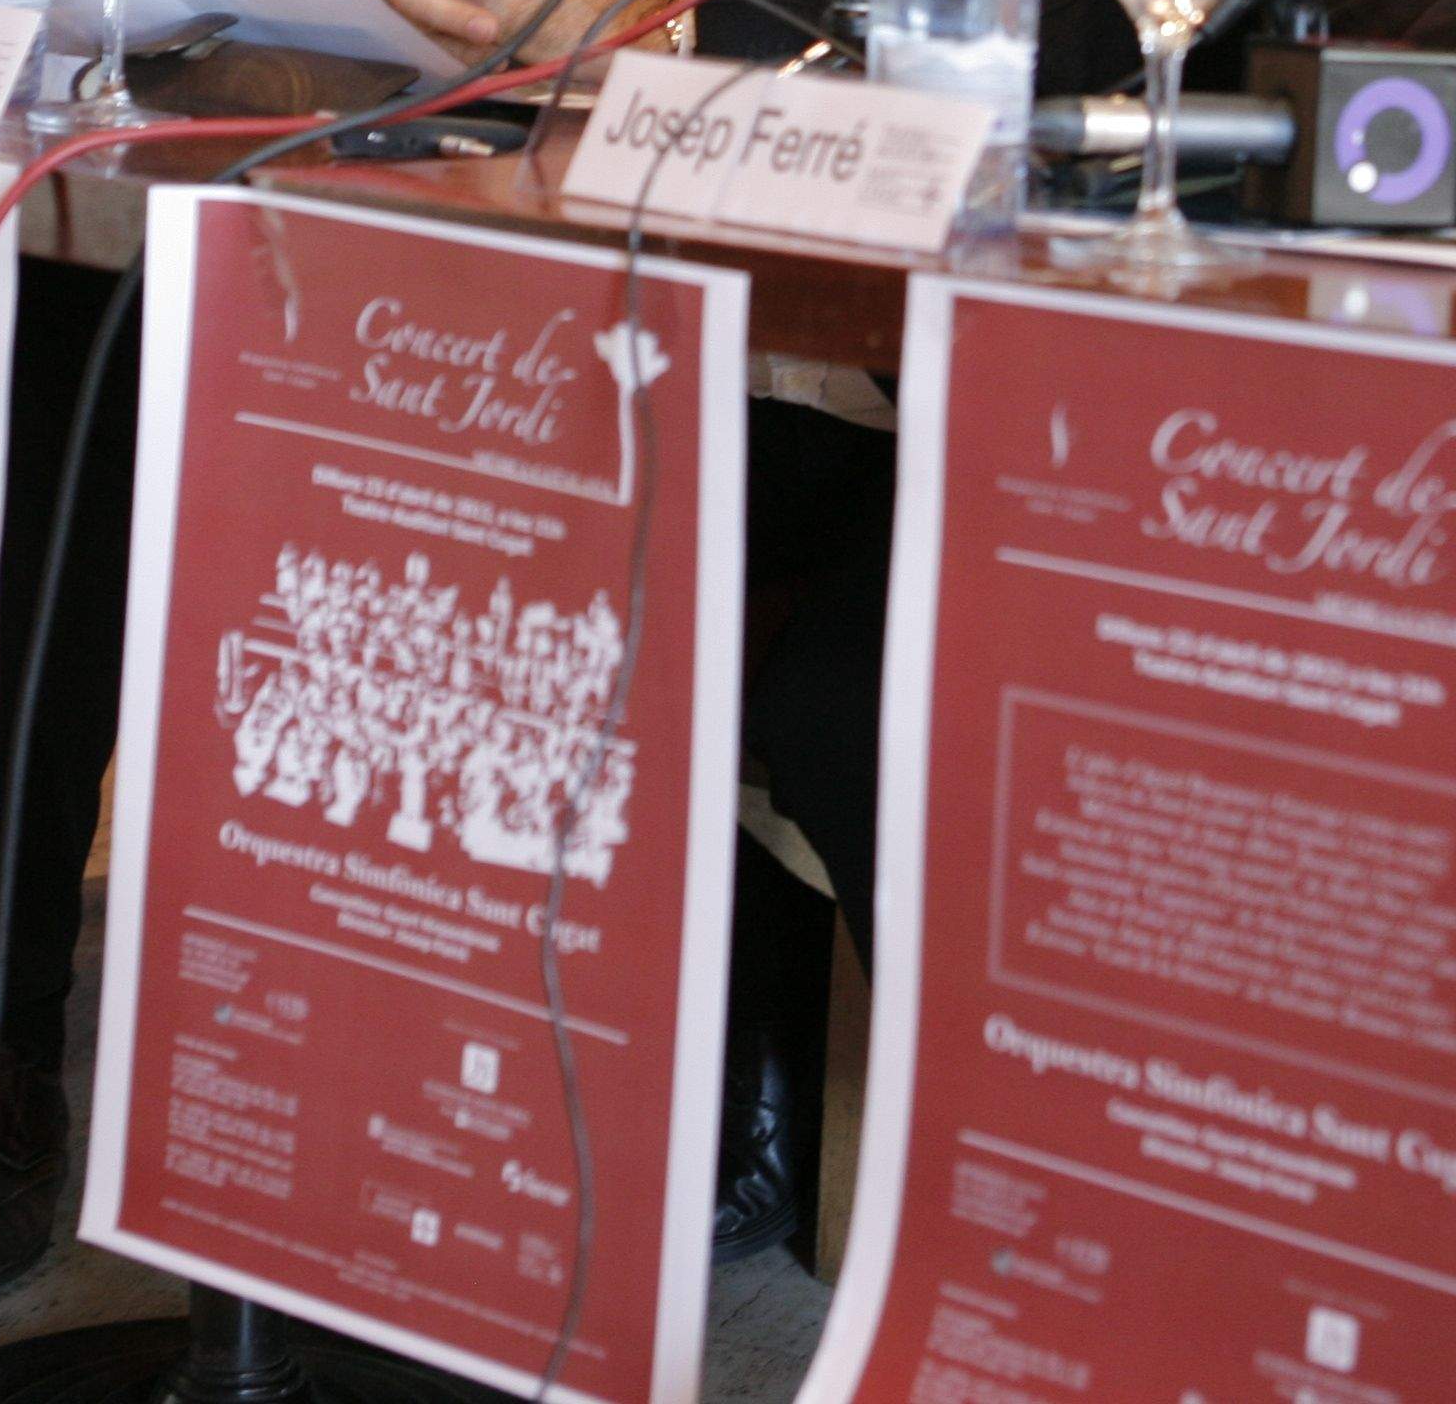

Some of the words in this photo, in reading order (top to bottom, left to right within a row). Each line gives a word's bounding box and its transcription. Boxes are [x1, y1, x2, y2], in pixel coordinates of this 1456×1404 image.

[606, 89, 733, 174] Josep
[741, 108, 867, 182] Ferré
[355, 296, 508, 372] Concert
[512, 308, 577, 387] de
[349, 352, 444, 417] Sant
[439, 370, 574, 444] Jordi
[1150, 408, 1369, 495] Concert
[1141, 476, 1276, 557] Sant
[219, 820, 341, 878] Orquestra
[465, 885, 524, 929] Sant
[984, 1013, 1140, 1090] Orquestra
[1311, 1102, 1392, 1163] Sant
